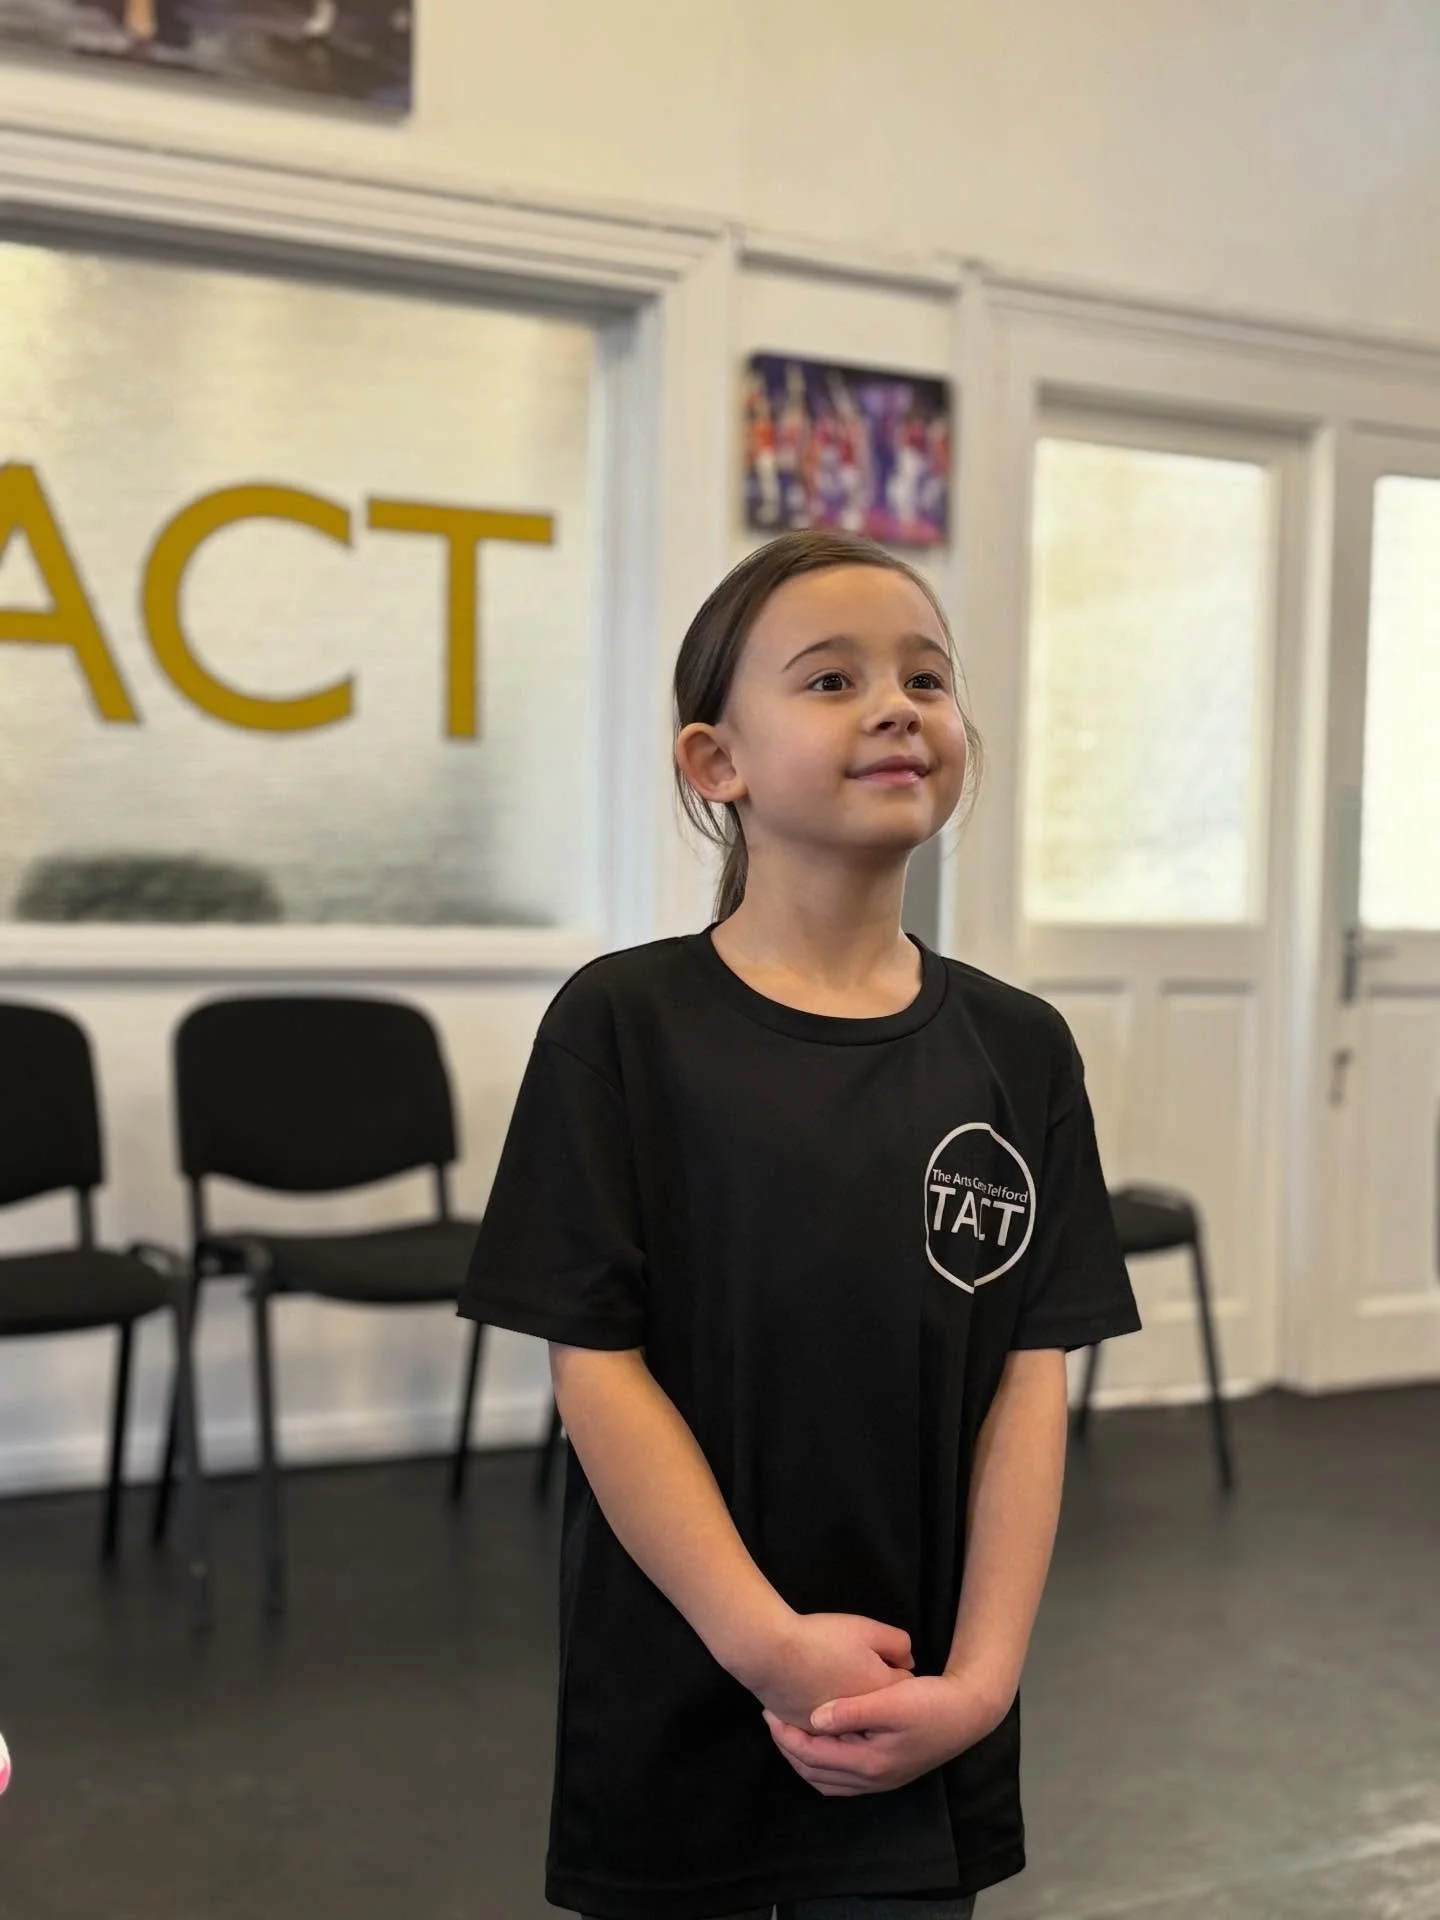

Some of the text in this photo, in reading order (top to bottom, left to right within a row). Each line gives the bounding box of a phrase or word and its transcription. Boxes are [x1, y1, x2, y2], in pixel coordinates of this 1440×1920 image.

[932, 1168, 952, 1184] The
[953, 1172, 972, 1187] Arts
[987, 1183, 1029, 1203] Telford
[929, 1184, 1026, 1247] TACT
